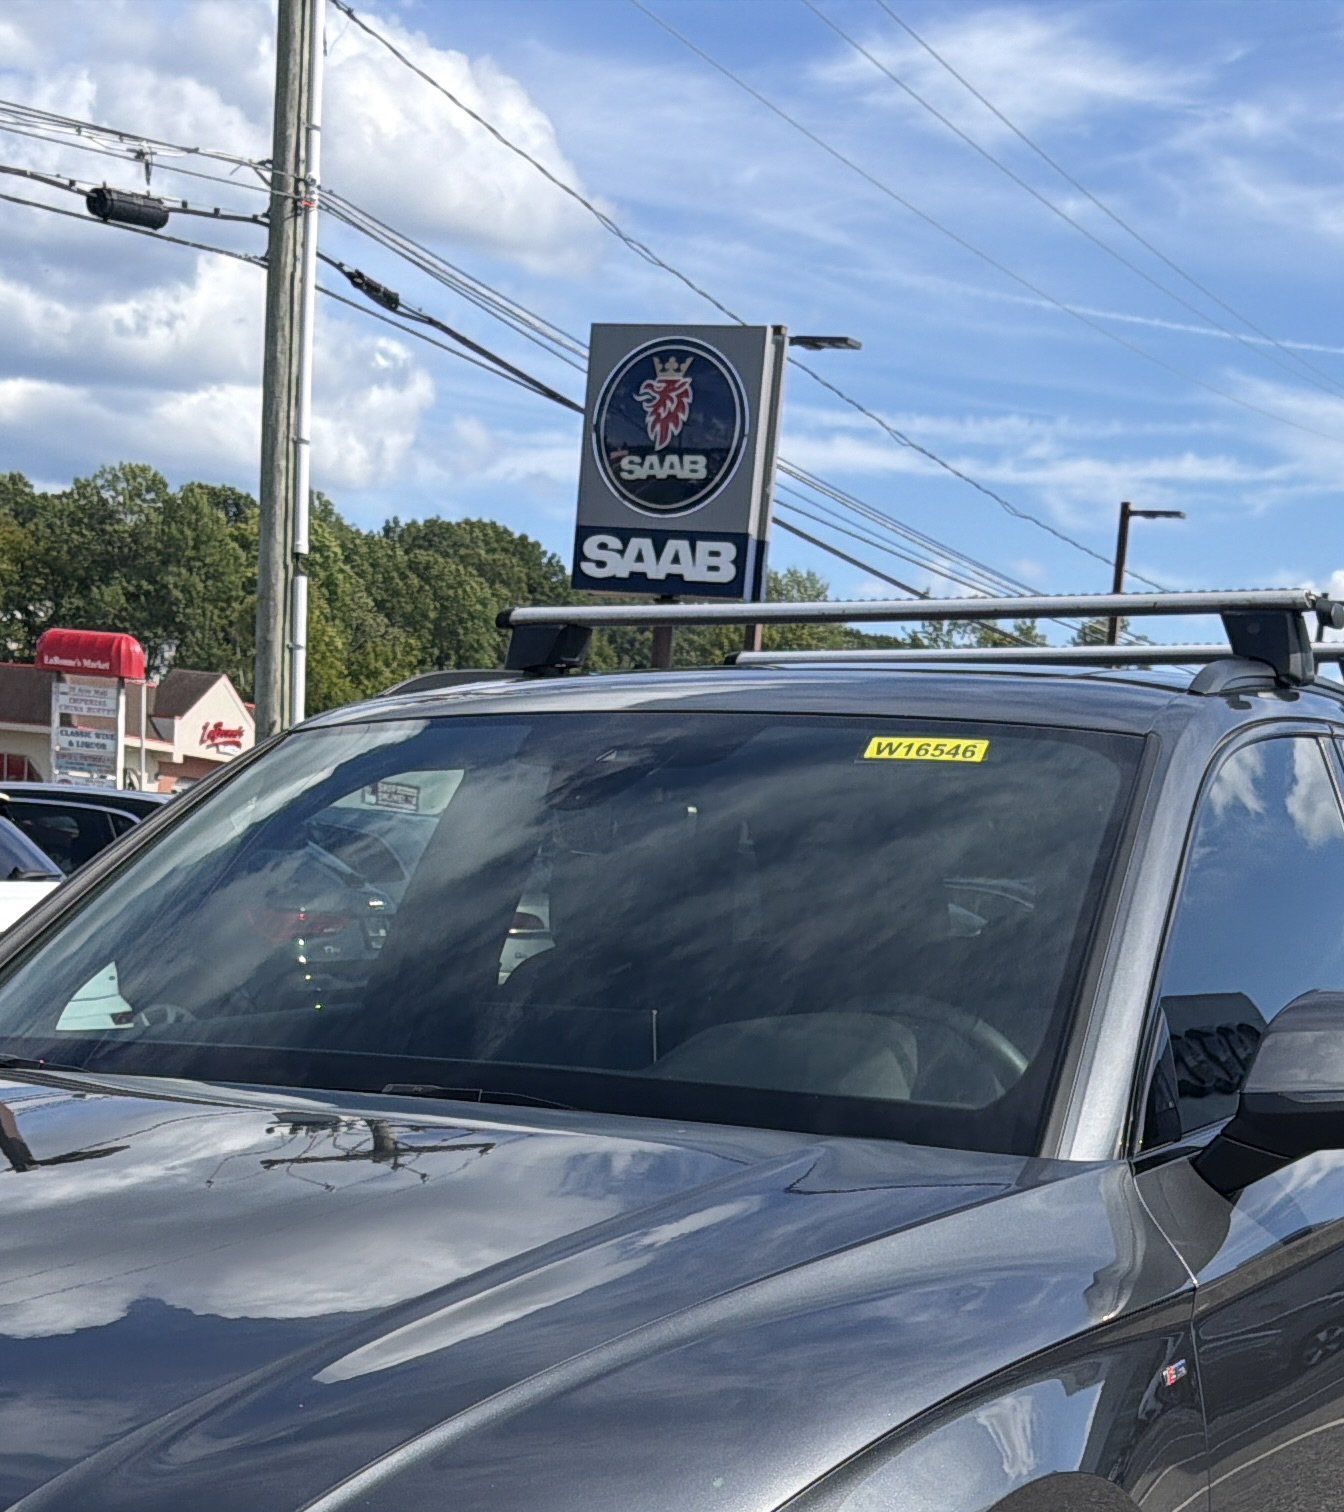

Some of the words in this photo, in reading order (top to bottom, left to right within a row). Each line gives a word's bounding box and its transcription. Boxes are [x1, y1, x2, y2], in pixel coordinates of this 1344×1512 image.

[620, 454, 707, 480] SAAB
[580, 534, 737, 584] SAAB
[83, 658, 110, 670] Market
[875, 742, 978, 758] W16546
